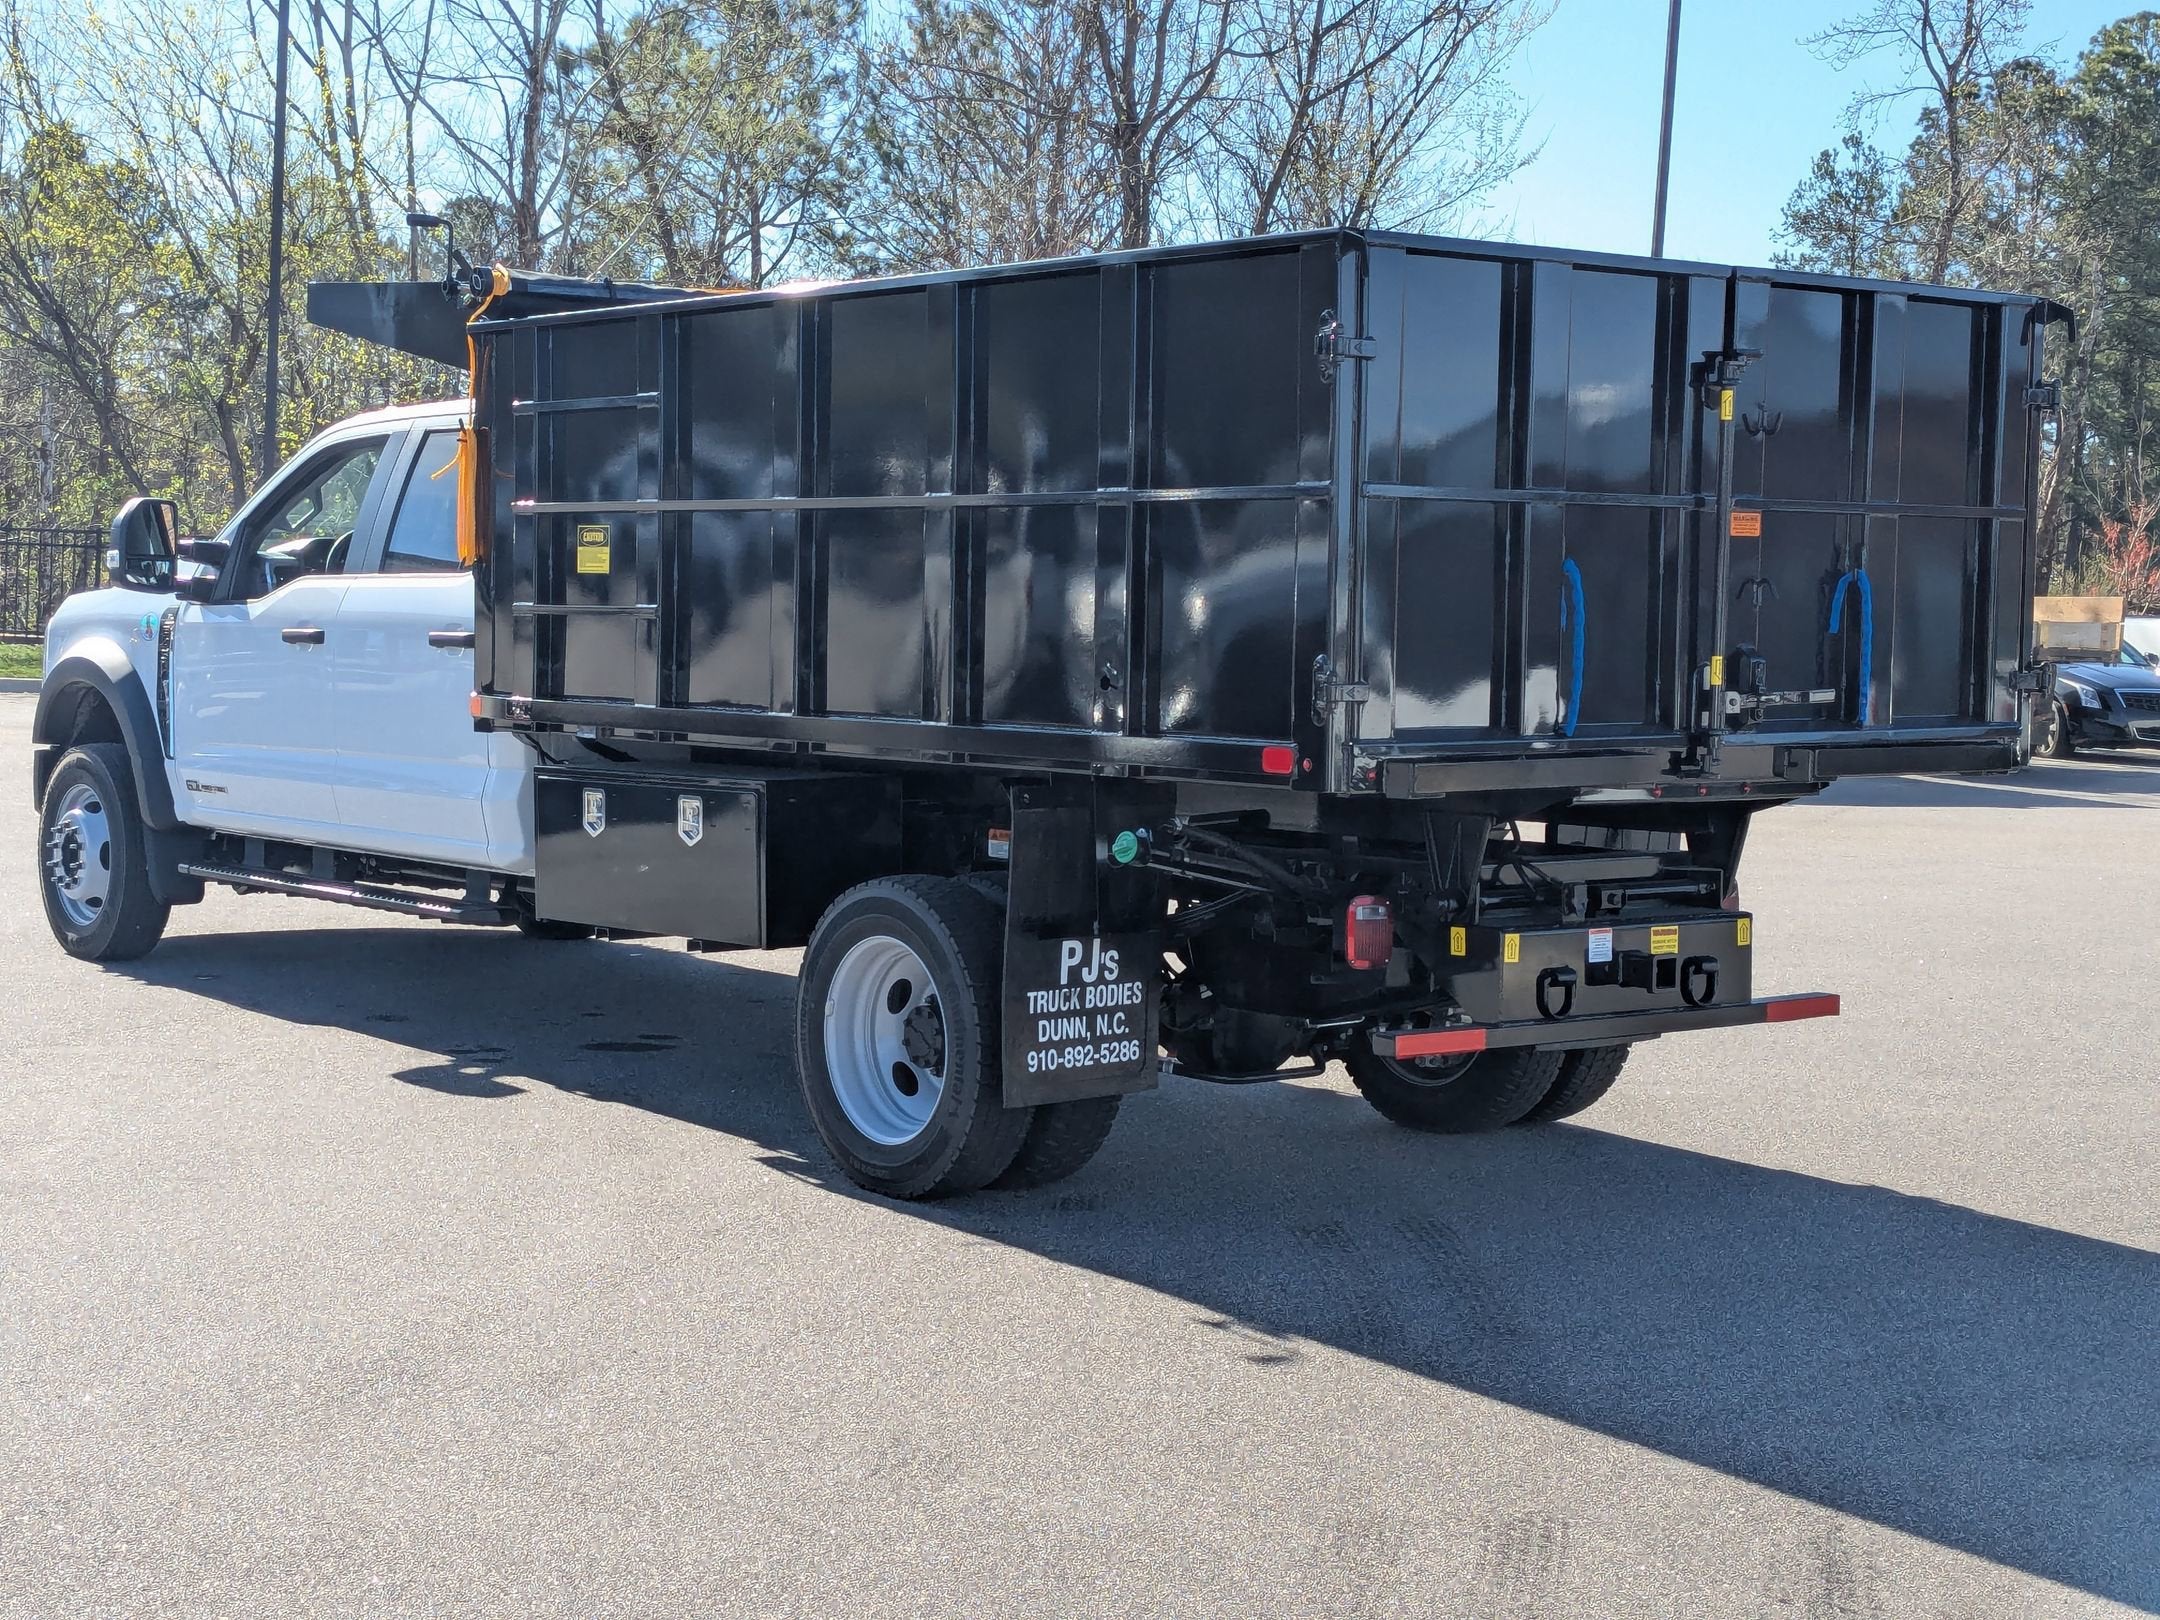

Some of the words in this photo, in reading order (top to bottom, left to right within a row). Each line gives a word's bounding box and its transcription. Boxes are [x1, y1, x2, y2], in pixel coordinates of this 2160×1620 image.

[1027, 987, 1081, 1014] TRUCK
[1085, 981, 1142, 1009] BODIES
[1038, 1016, 1091, 1042] DUNN,
[1096, 1012, 1129, 1037] N.C.
[1027, 1040, 1140, 1073] 910-892-5286
